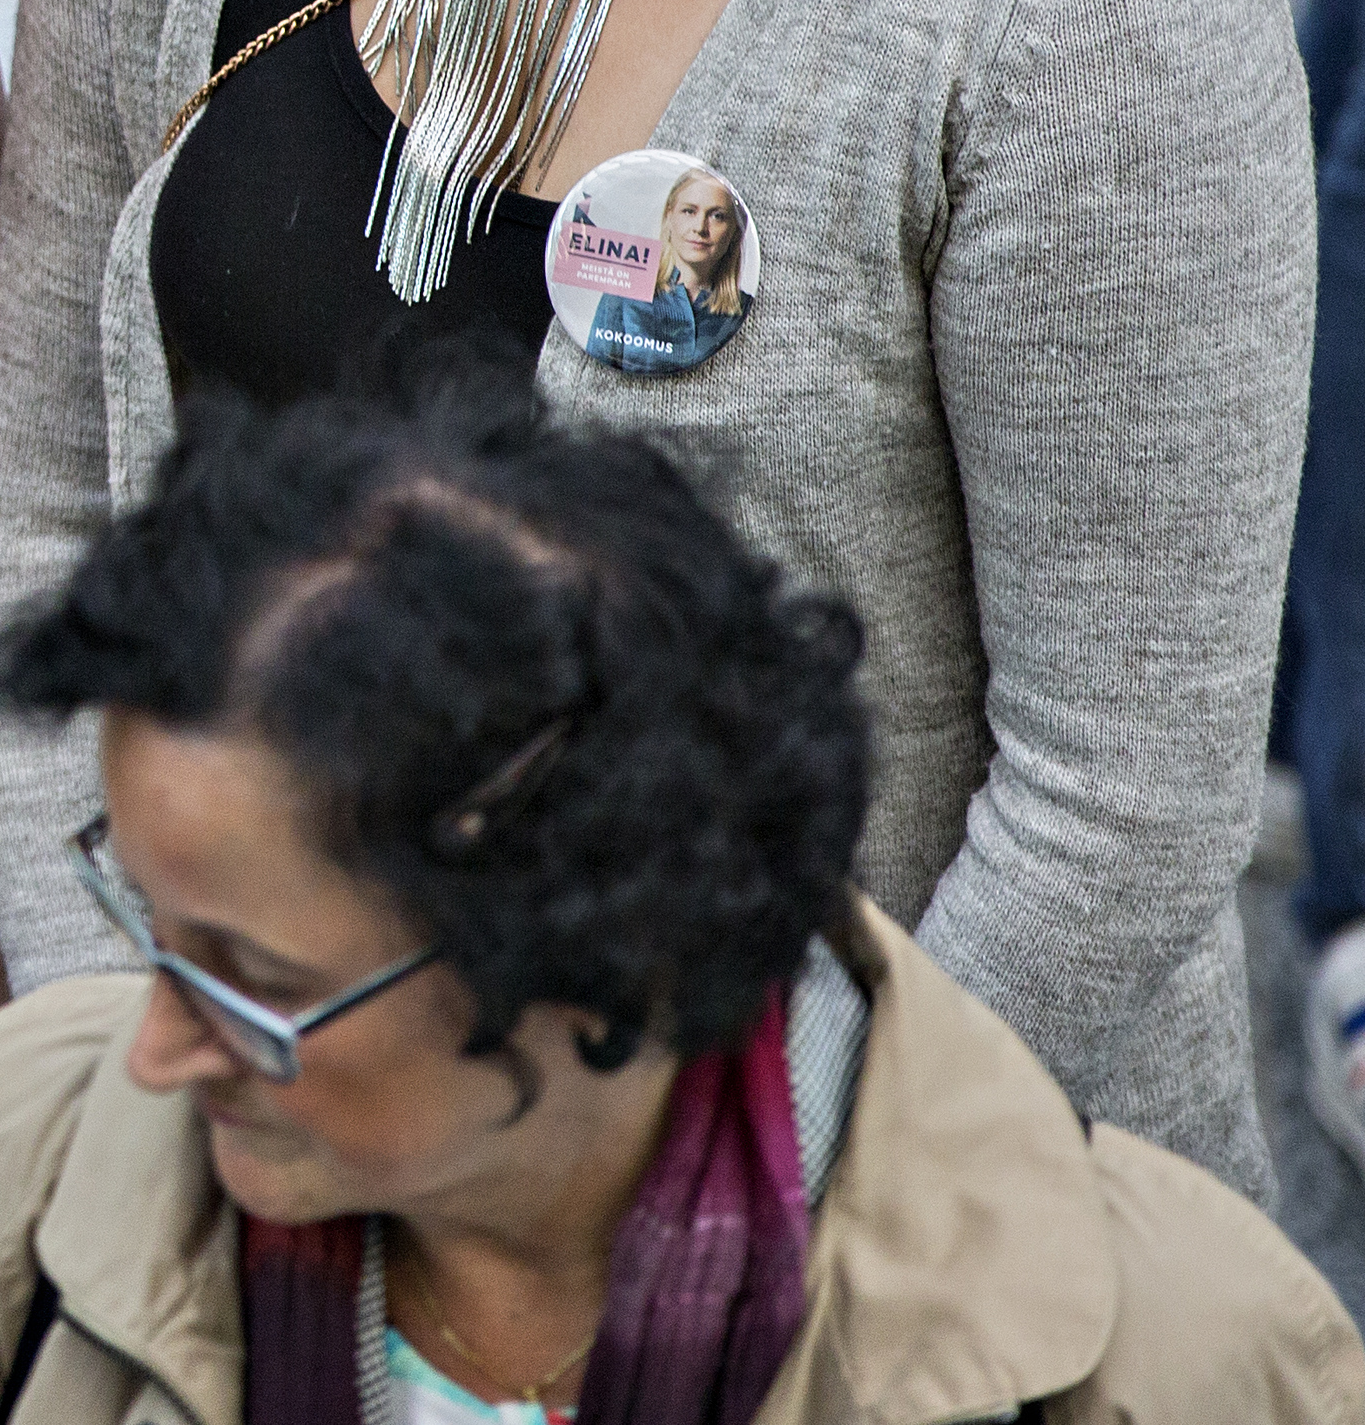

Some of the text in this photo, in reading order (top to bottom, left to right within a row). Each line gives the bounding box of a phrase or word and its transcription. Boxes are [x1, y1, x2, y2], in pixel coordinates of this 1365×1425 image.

[569, 232, 650, 264] ELINA!
[576, 271, 632, 289] PAREMPAAN
[581, 263, 631, 280] MEISTÄ ON
[595, 327, 673, 354] KOKOOMUS
